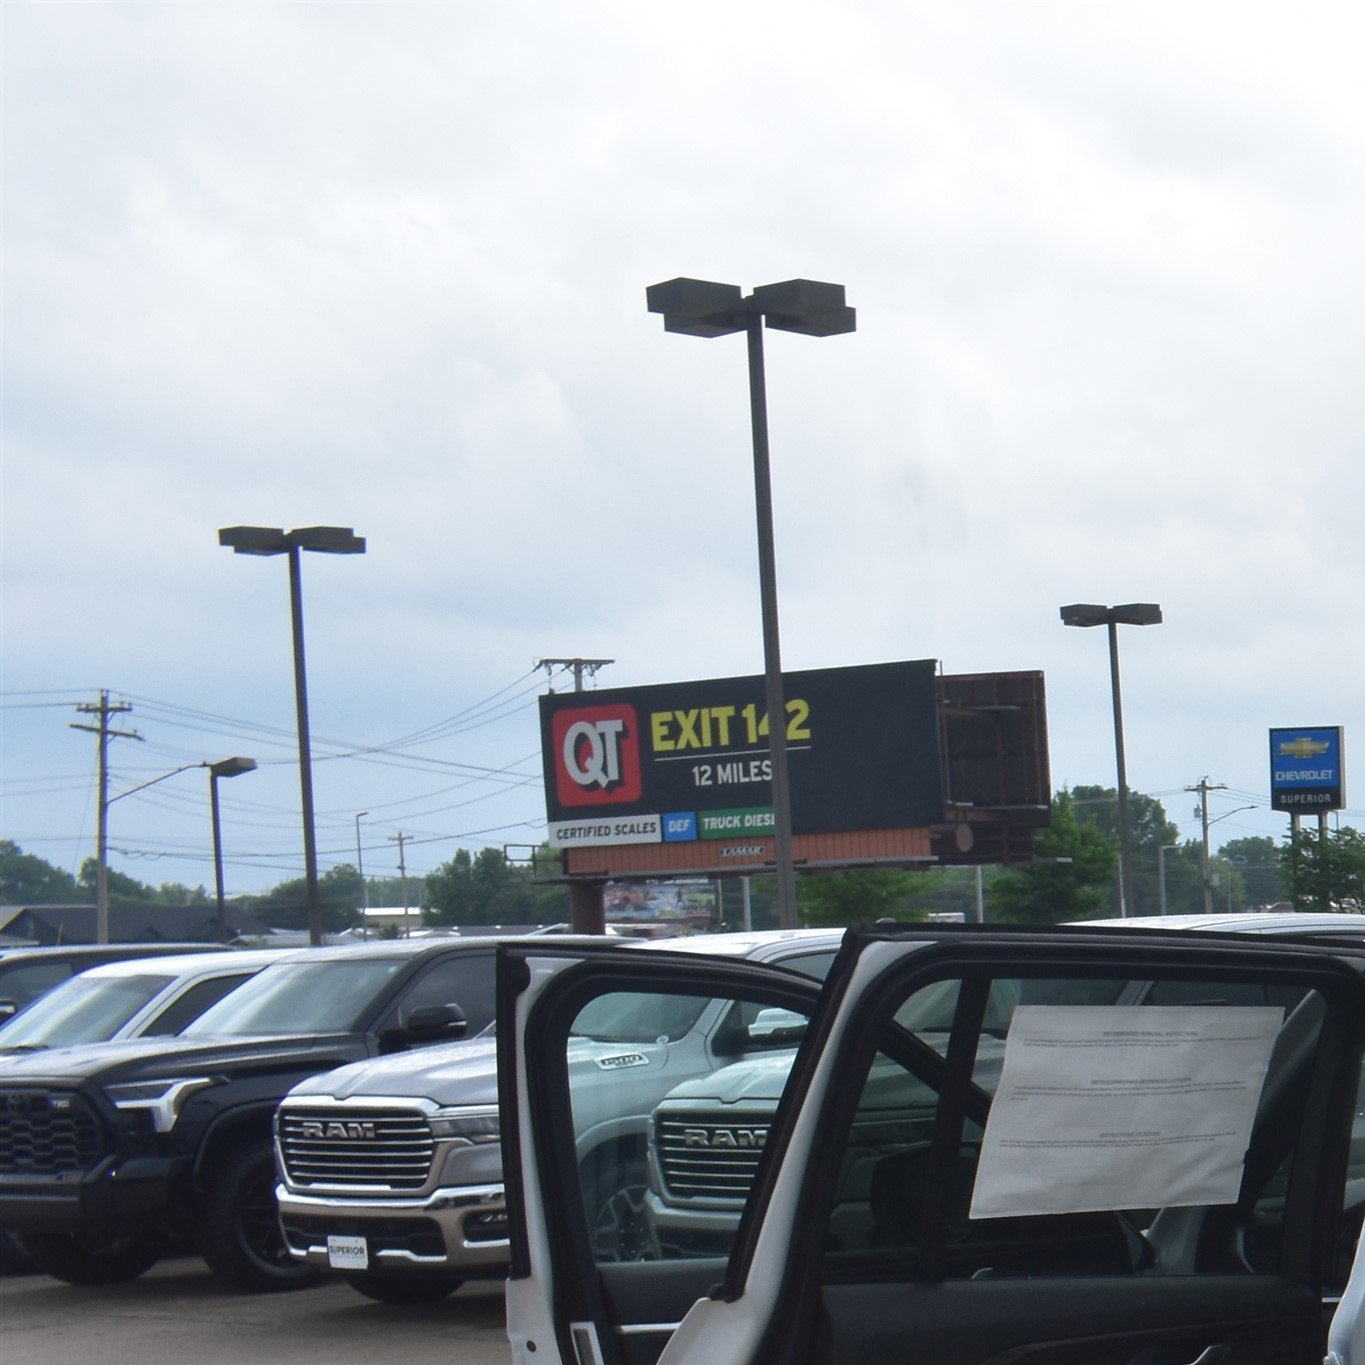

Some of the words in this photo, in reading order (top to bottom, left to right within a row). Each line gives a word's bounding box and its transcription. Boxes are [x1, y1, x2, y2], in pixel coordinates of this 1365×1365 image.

[651, 705, 735, 751] EXIT
[563, 719, 623, 788] QT
[692, 765, 713, 786] 12
[717, 760, 773, 784] MILES
[1275, 769, 1334, 781] CHEVROLET
[1280, 793, 1332, 803] SUPERIOR
[668, 819, 691, 832] DEF
[704, 815, 741, 829] TRUCK
[744, 813, 775, 827] DIES
[556, 825, 611, 840] CERTIFIED
[614, 822, 657, 835] SCALES
[721, 846, 761, 857] LAMAR
[302, 1121, 375, 1138] RAM
[684, 1129, 768, 1146] RAM
[329, 1245, 365, 1255] SUPERIOR
